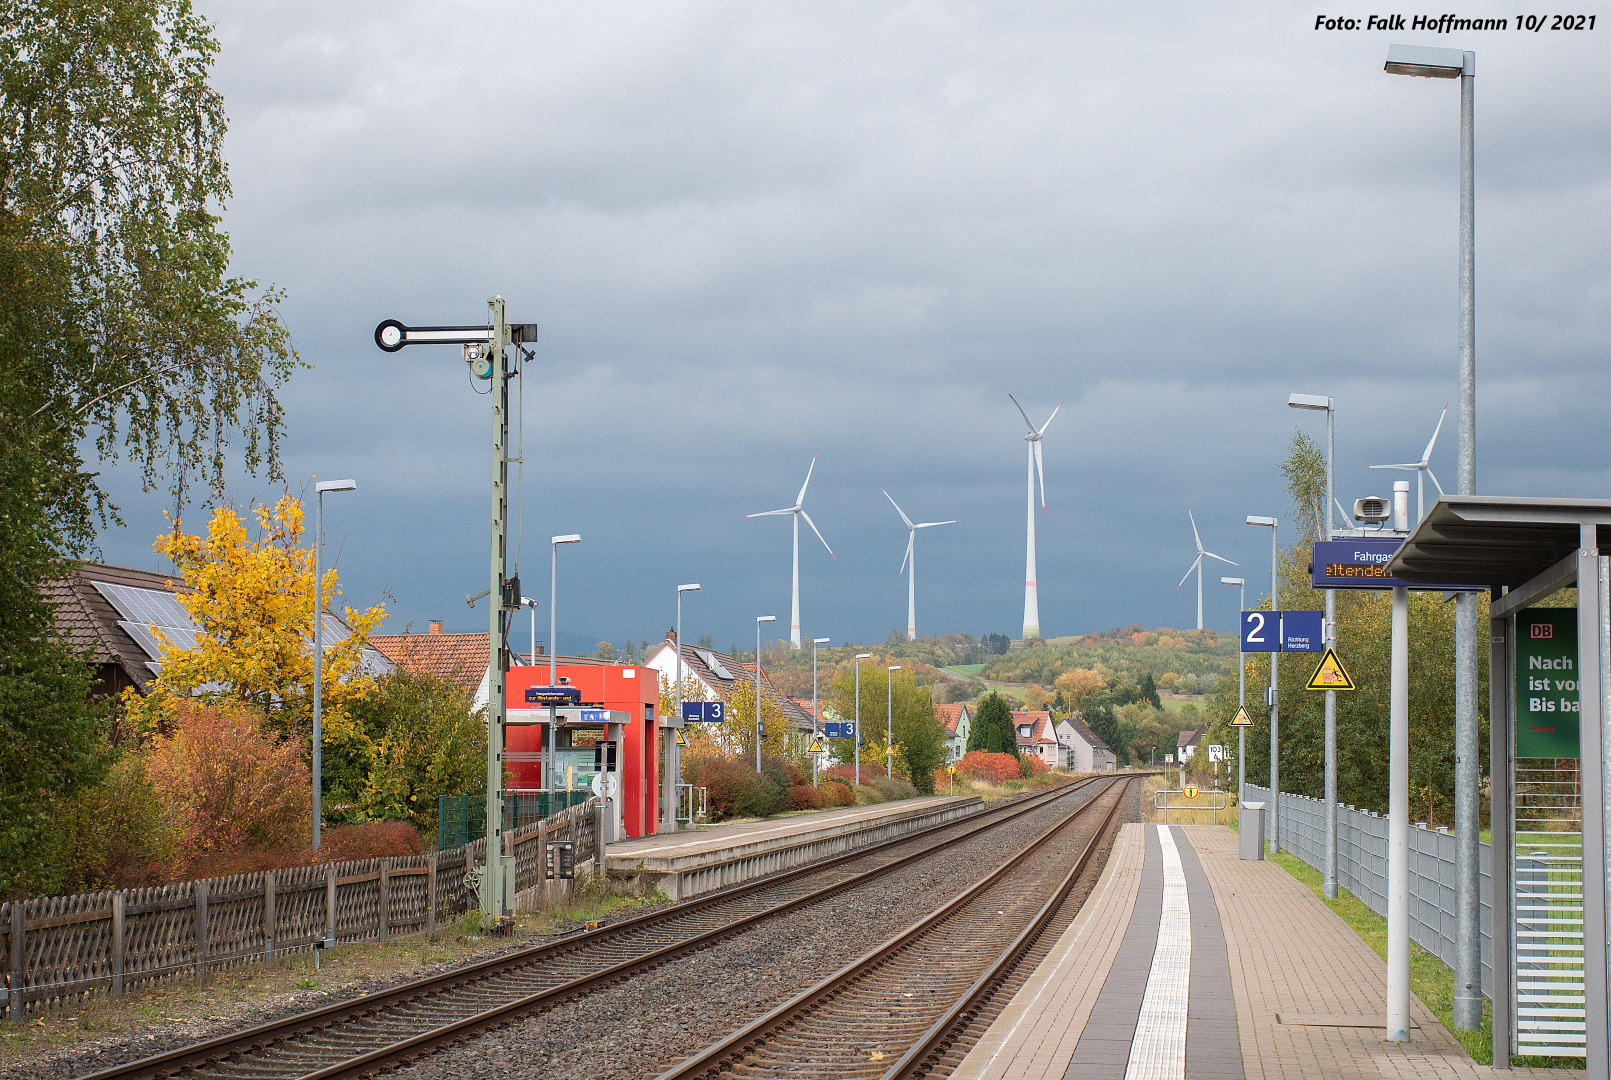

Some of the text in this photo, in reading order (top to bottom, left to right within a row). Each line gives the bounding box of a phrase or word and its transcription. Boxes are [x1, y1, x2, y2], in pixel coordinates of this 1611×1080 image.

[1246, 612, 1265, 642] 2
[1531, 624, 1552, 638] DB
[1529, 655, 1573, 670] Nach
[1529, 676, 1550, 690] ist
[711, 703, 722, 718] 3
[1529, 696, 1556, 712] Bis
[846, 724, 854, 734] 3
